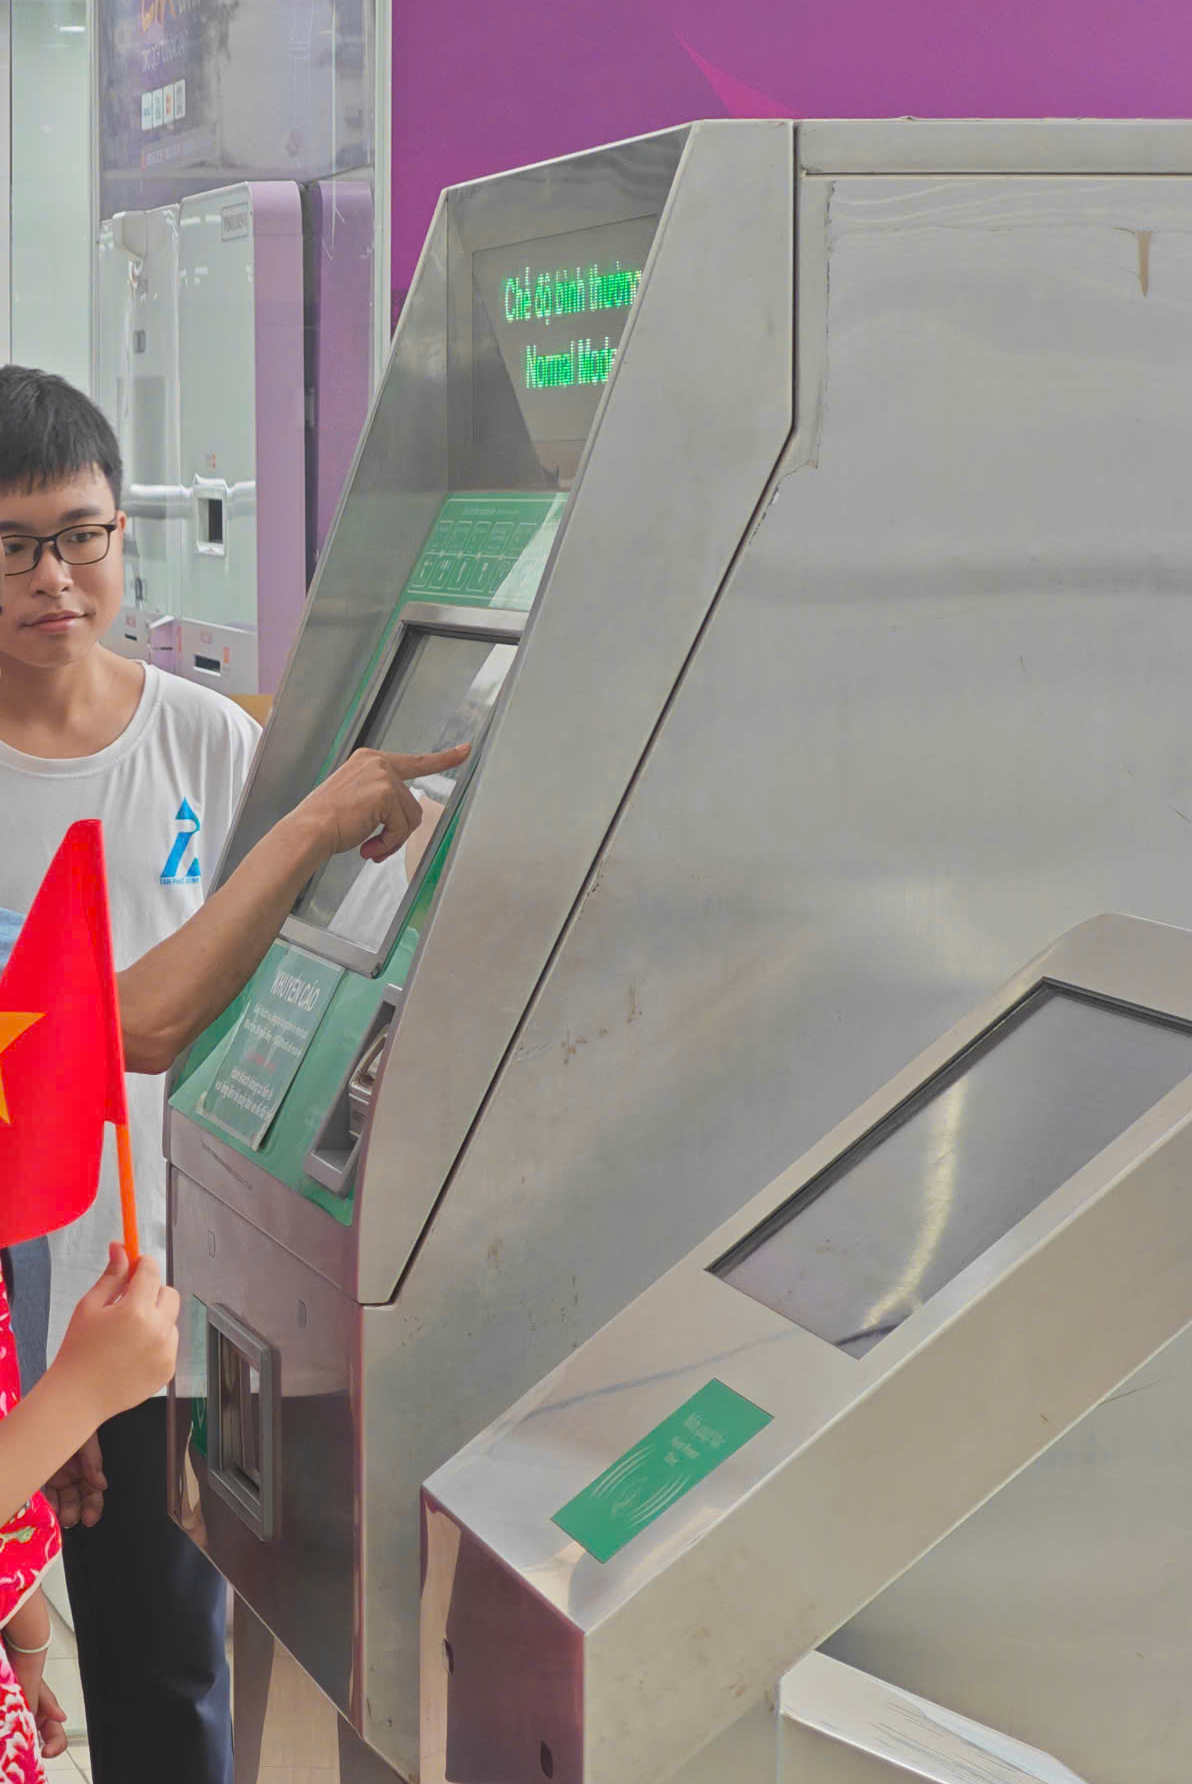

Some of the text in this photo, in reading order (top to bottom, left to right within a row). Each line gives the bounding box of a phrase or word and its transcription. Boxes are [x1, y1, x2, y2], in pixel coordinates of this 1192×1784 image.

[505, 267, 531, 322] Chế
[526, 341, 575, 388] Normal
[297, 979, 321, 1011] CÁO
